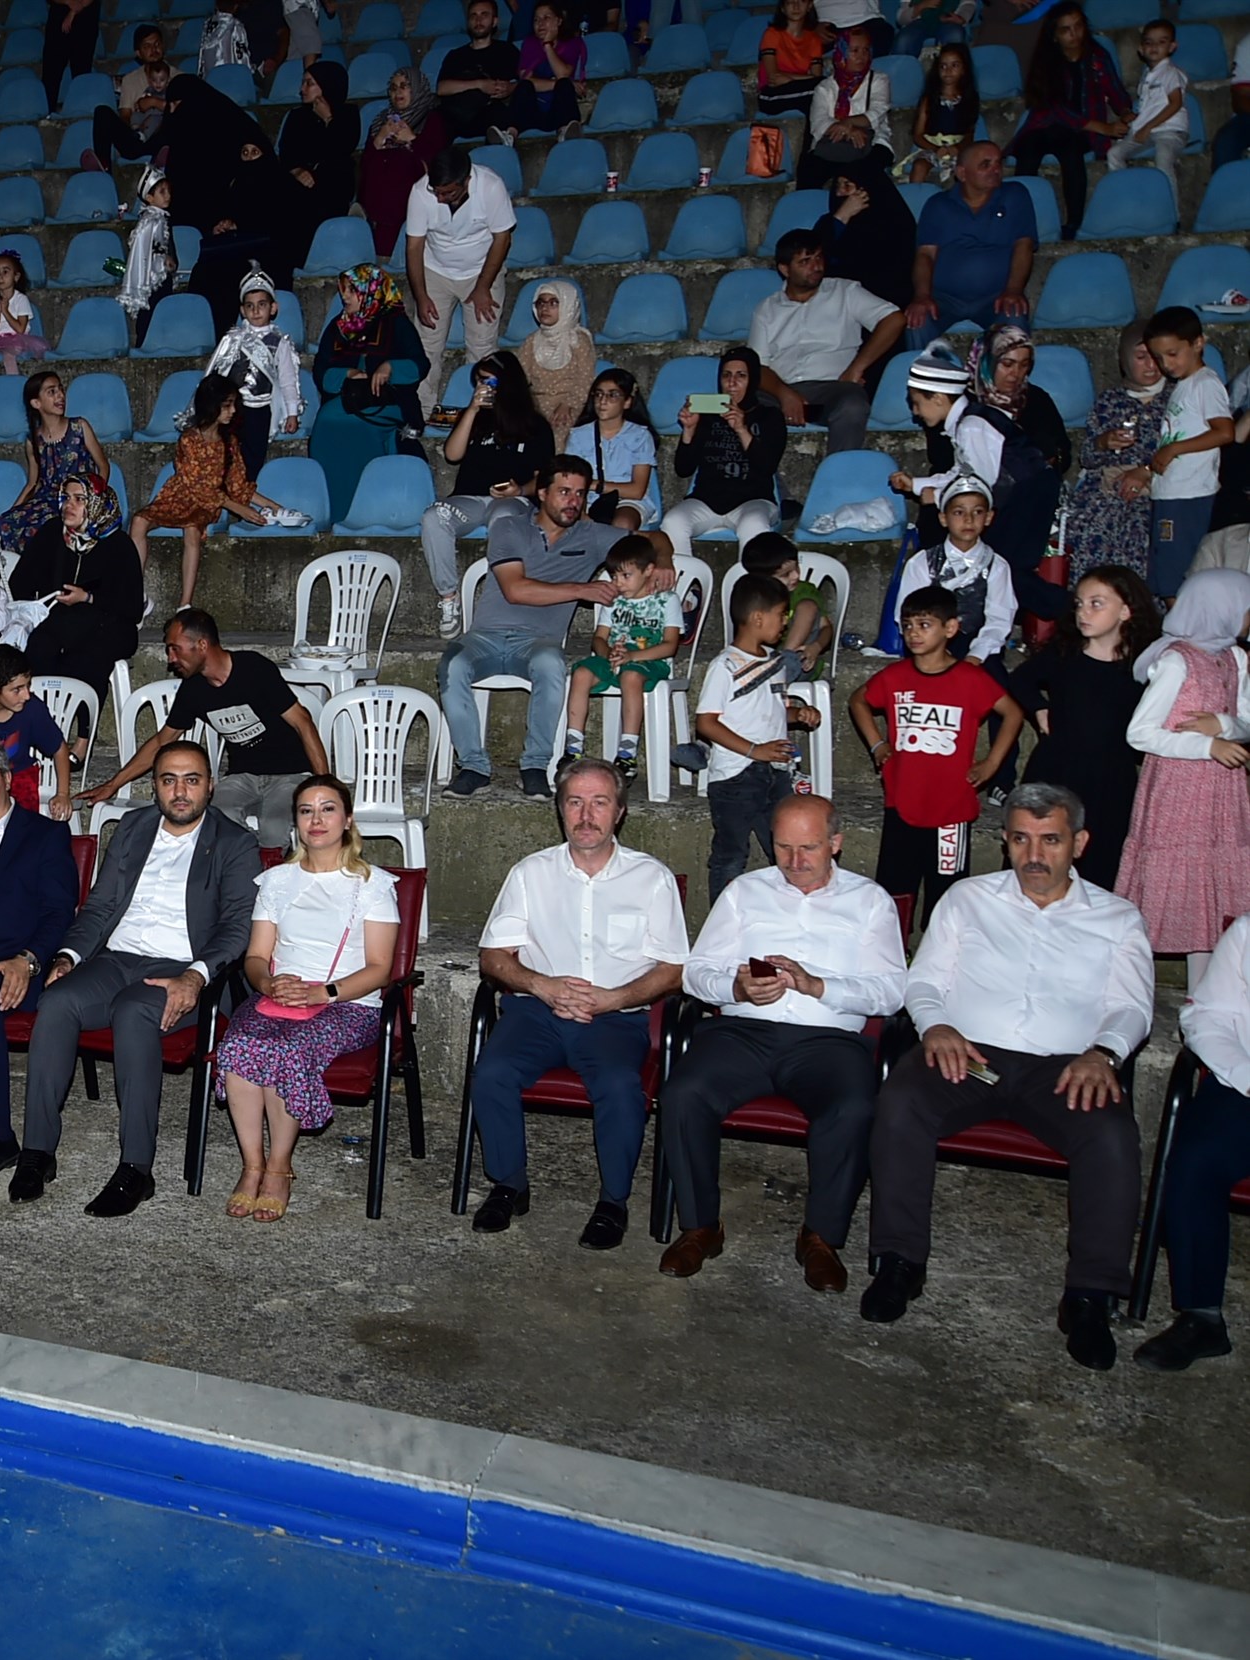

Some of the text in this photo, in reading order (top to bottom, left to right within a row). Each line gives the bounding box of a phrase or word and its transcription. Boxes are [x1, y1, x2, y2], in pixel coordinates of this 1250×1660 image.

[893, 690, 916, 703] THE
[219, 713, 247, 726] TRUST
[897, 705, 956, 728] REAL
